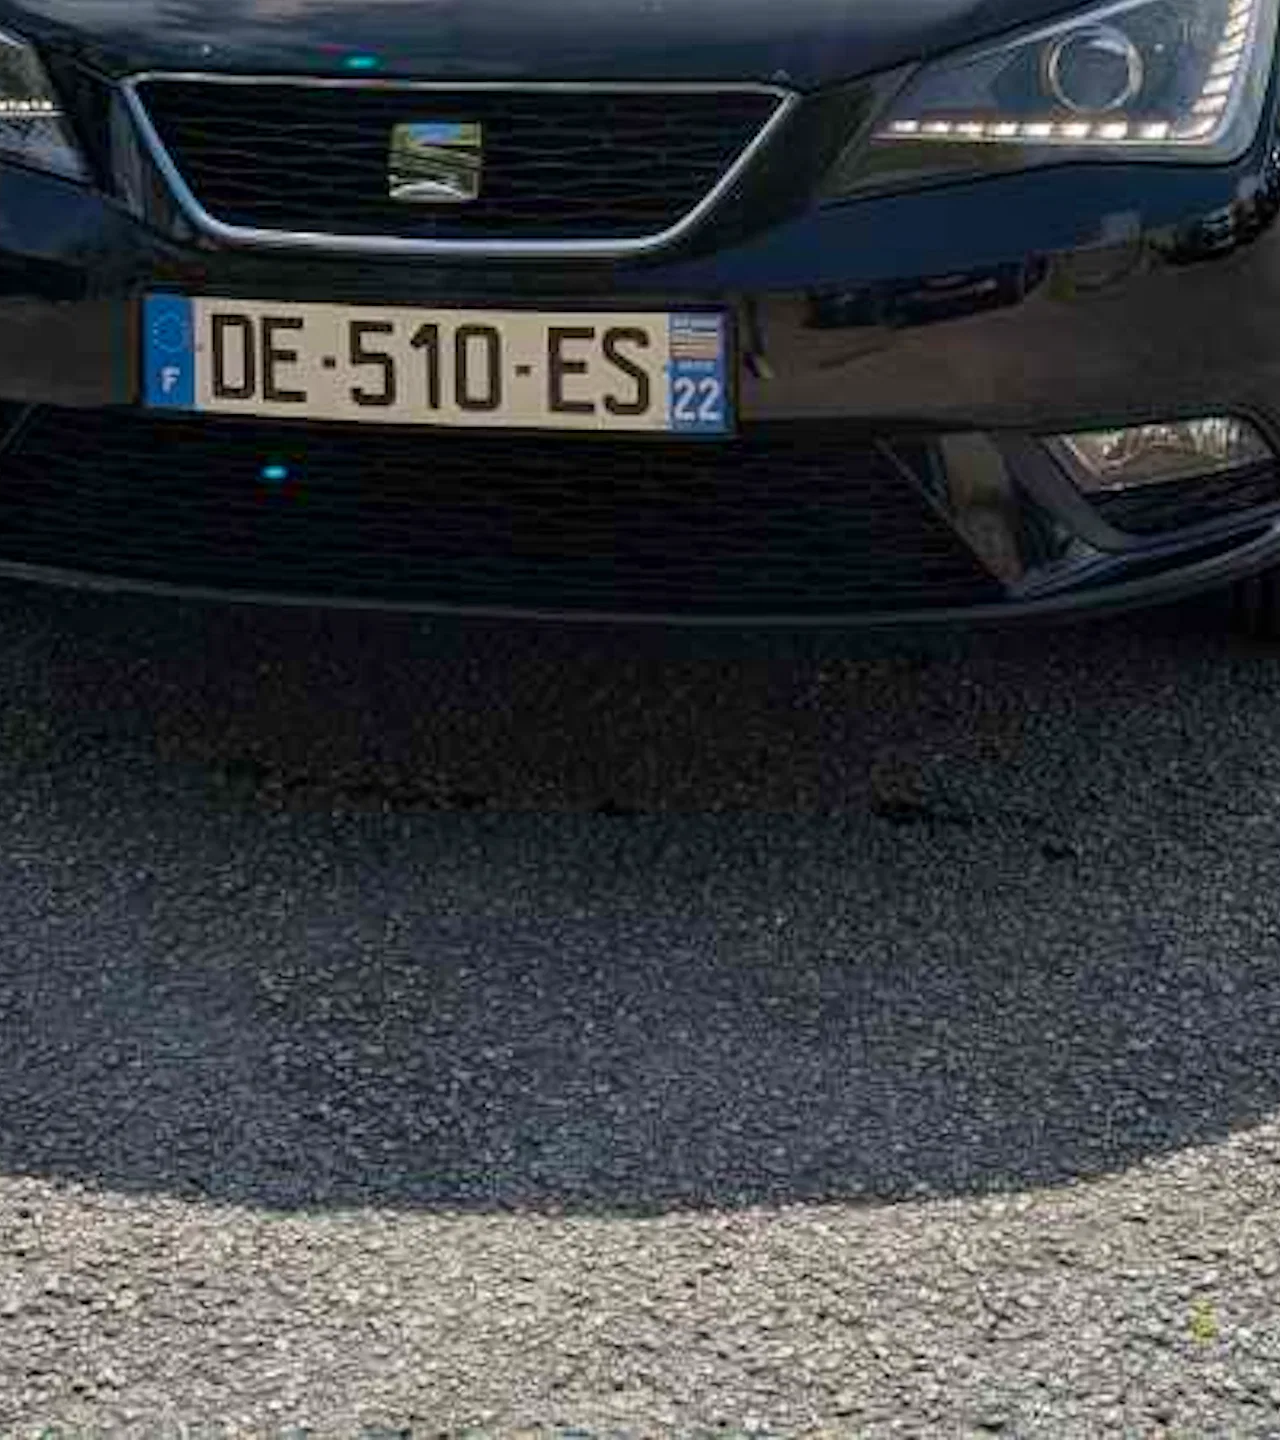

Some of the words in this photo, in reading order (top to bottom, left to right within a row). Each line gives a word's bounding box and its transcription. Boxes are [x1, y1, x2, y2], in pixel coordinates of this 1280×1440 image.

[160, 366, 181, 394] F
[211, 313, 650, 416] DE-510-ES
[672, 376, 721, 422] 22
